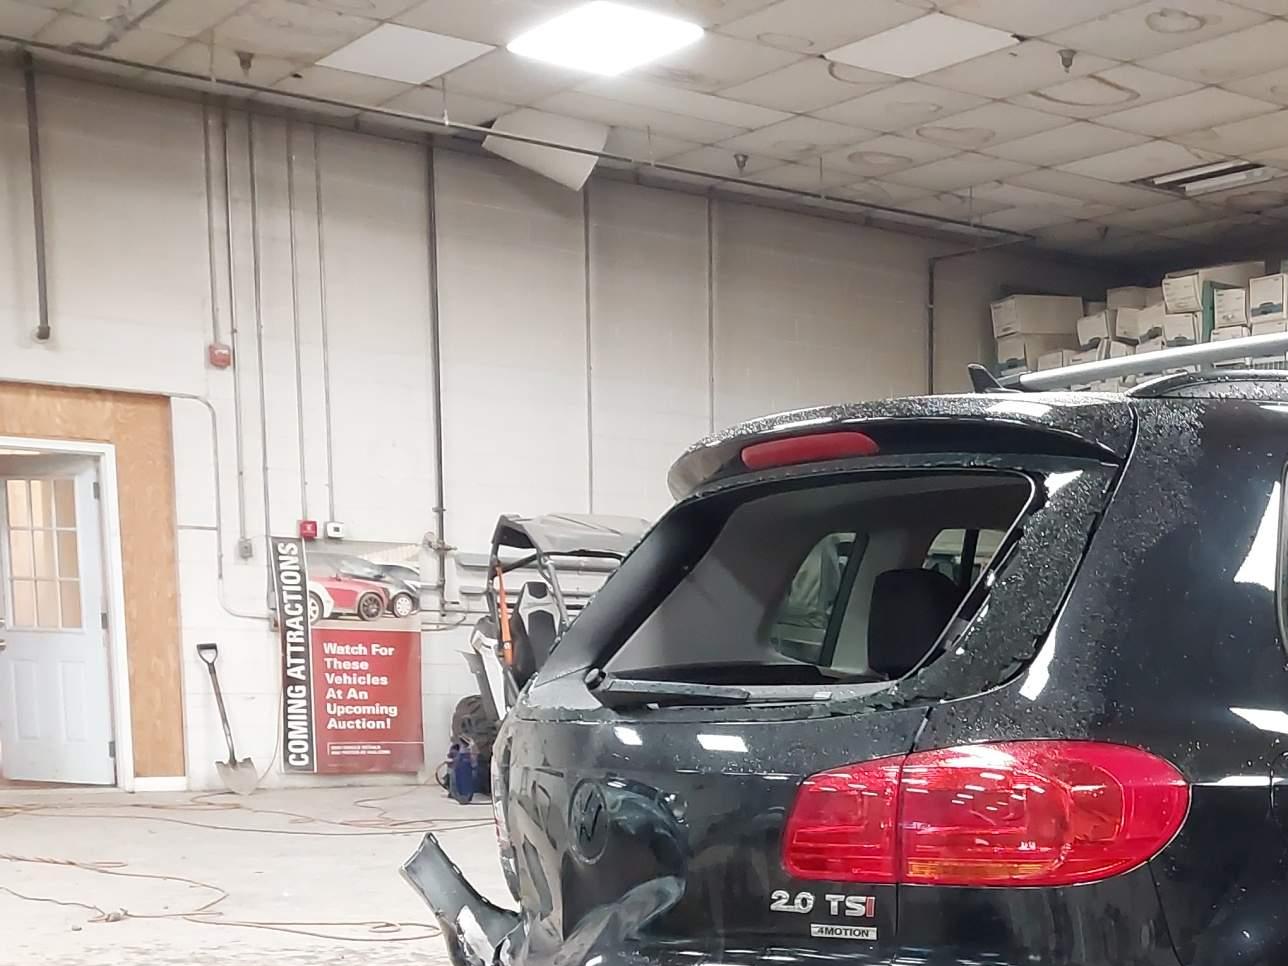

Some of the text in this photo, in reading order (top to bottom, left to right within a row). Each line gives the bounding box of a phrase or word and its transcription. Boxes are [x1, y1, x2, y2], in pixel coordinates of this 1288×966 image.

[278, 542, 310, 767] COMING ATTRACTIONS
[323, 642, 395, 656] Watch For
[324, 657, 369, 670] These
[325, 672, 389, 685] Vehicles
[325, 687, 369, 700] At An
[326, 702, 398, 717] Upcoming
[326, 717, 391, 729] Auction!
[825, 894, 876, 917] TSI
[817, 927, 869, 937] 4MOTION
